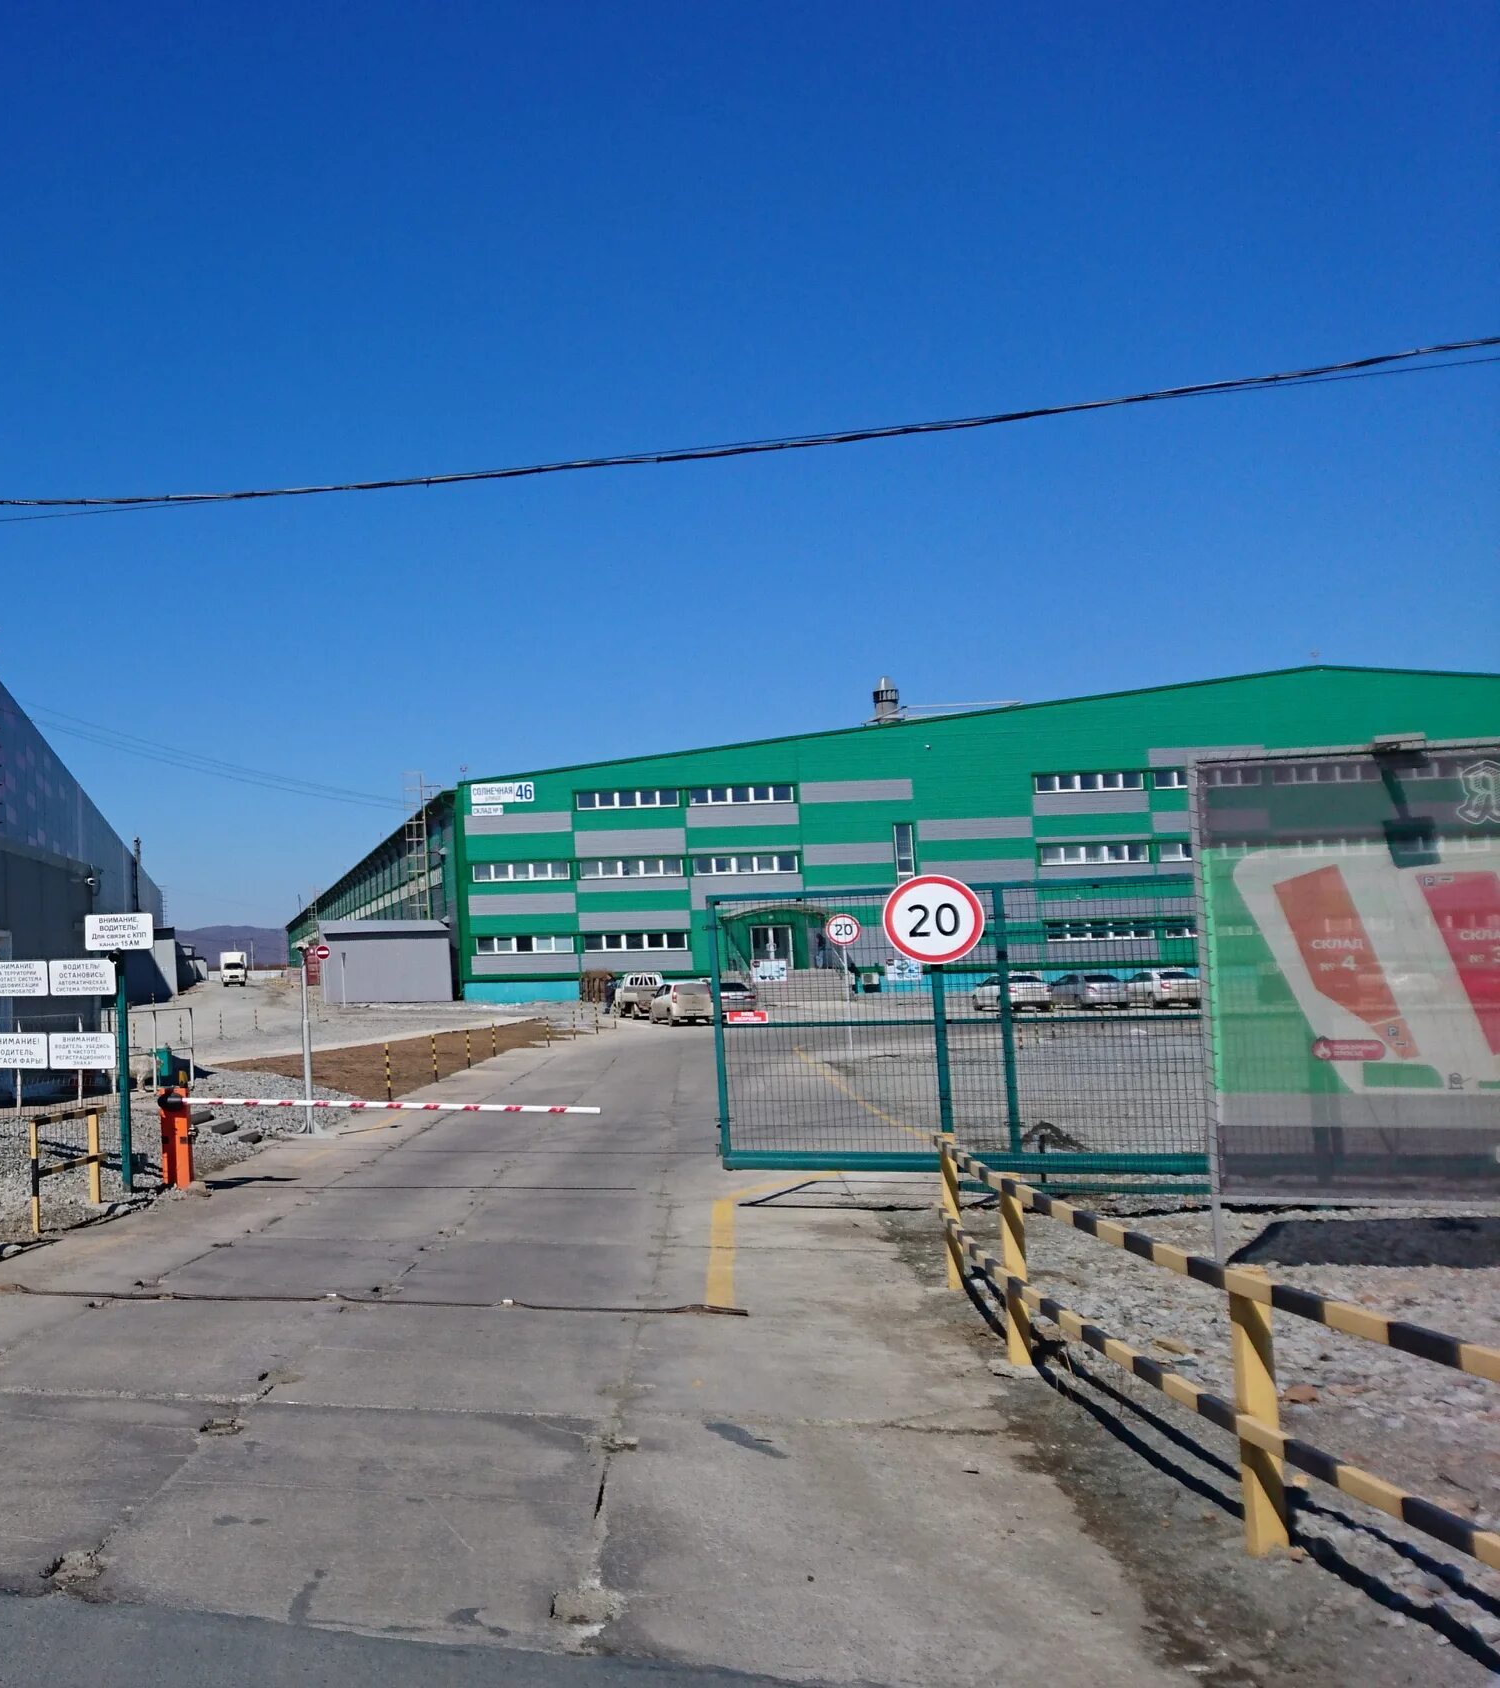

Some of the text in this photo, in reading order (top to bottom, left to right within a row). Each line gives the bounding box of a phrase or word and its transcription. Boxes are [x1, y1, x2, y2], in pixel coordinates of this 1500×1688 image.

[472, 784, 533, 800] СОЛНЕЧНАЯ 46
[907, 903, 961, 938] 20
[99, 924, 139, 932] ВОДИТЕЛЬ!
[834, 923, 853, 936] 20
[1311, 938, 1364, 950] СКЛАД
[62, 963, 100, 971] ВОДИТЕЛЬ!
[1341, 954, 1358, 971] 4
[19, 1057, 44, 1065] ФАРЫ!
